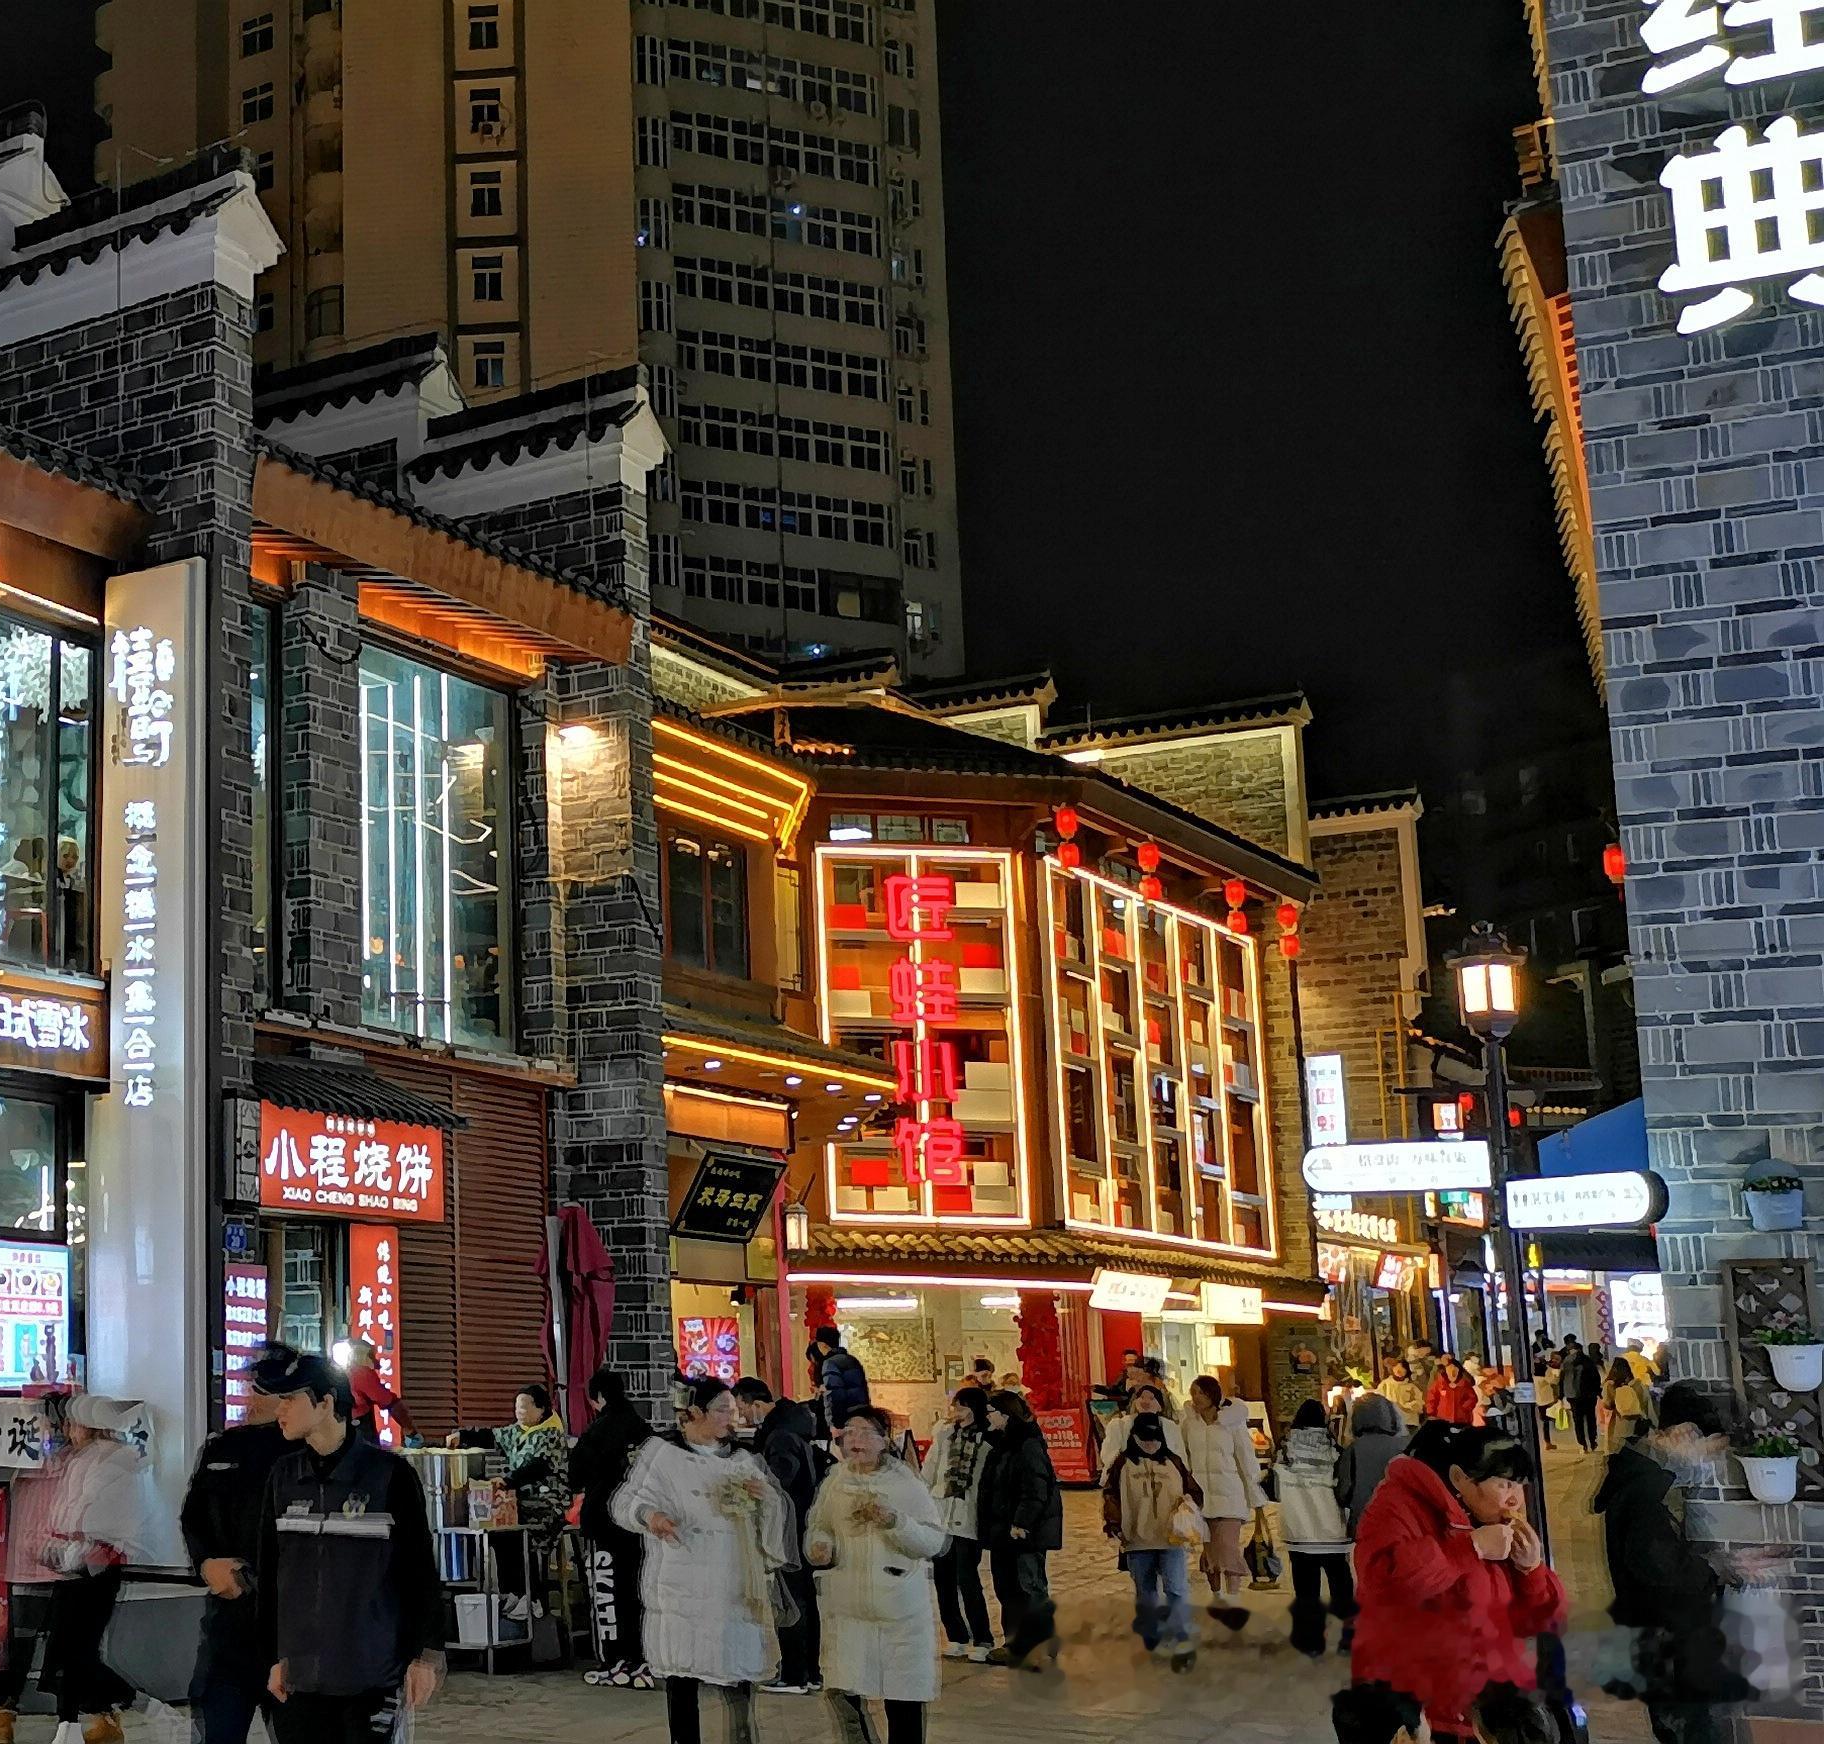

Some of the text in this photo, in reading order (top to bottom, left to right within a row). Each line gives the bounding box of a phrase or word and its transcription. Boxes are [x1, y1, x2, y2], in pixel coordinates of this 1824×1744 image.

[884, 874, 965, 1186] 匠蛙小馆
[264, 1128, 433, 1199] 小程烧饼
[282, 1186, 312, 1202] XIAO
[316, 1188, 355, 1206] CHENG
[358, 1194, 389, 1209] SHAO
[594, 1550, 617, 1641] SKATE
